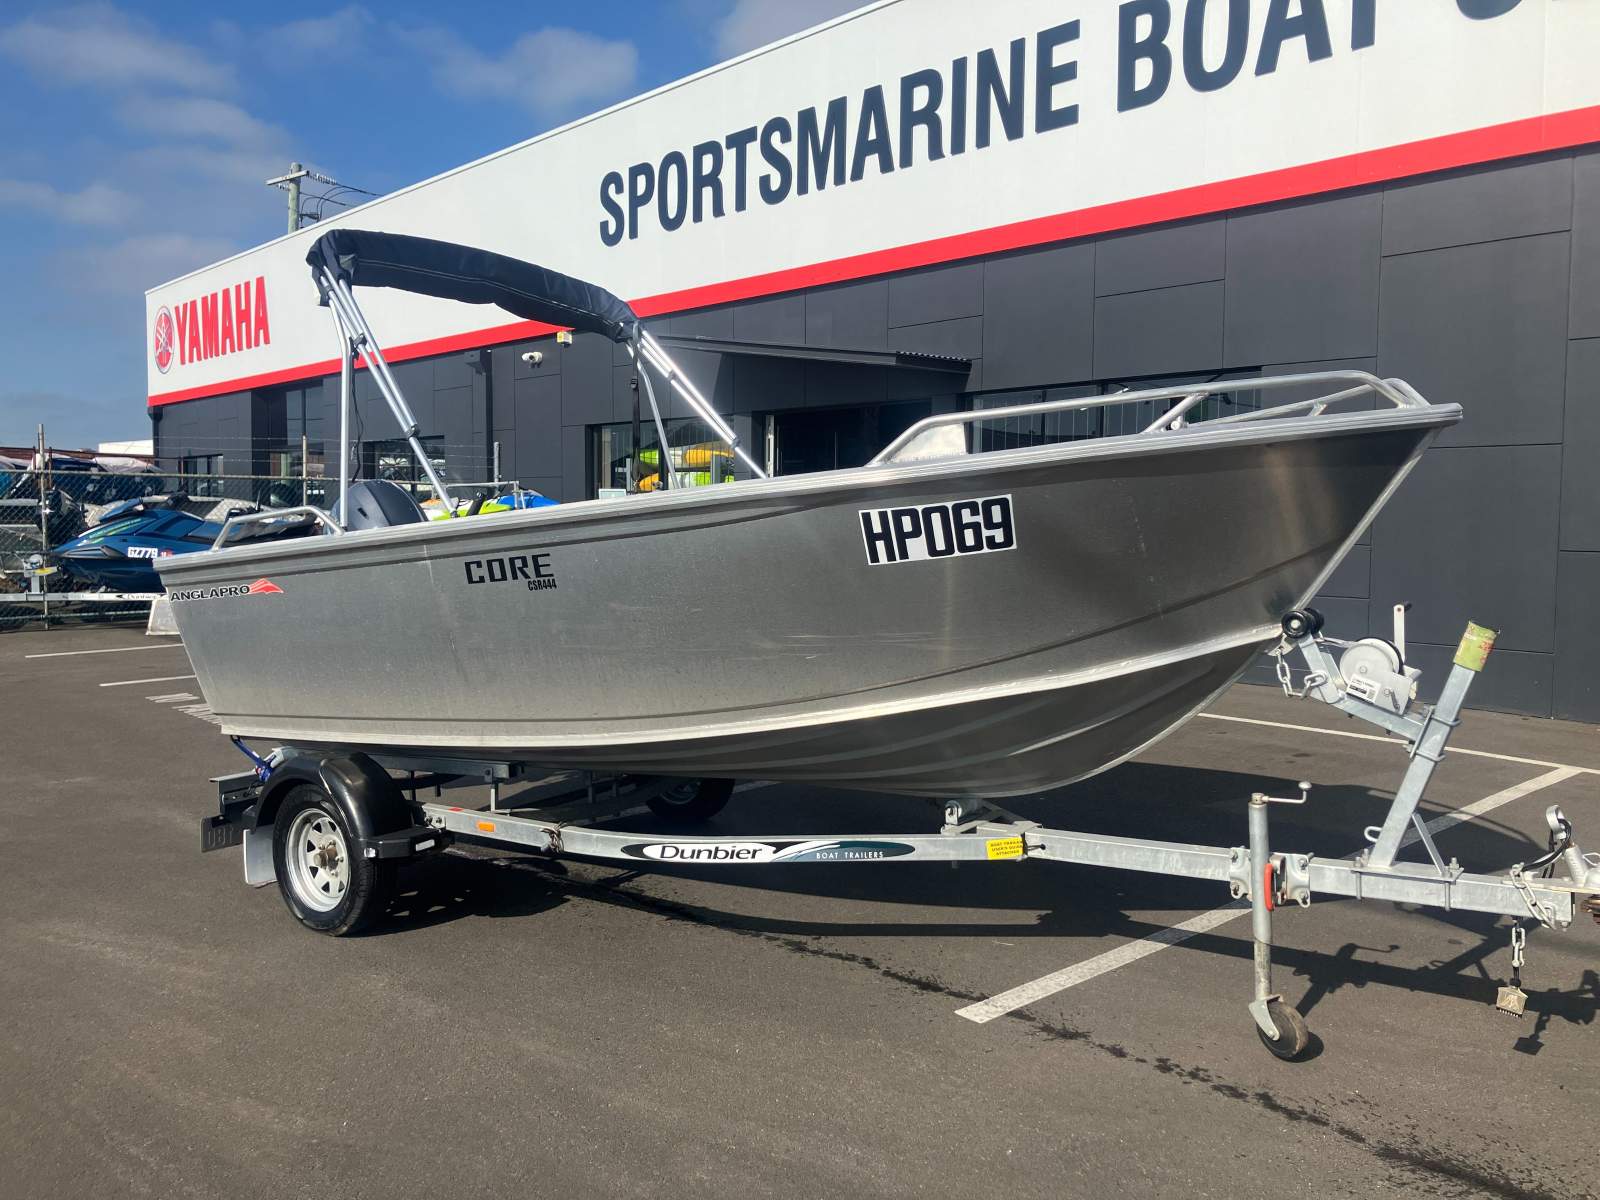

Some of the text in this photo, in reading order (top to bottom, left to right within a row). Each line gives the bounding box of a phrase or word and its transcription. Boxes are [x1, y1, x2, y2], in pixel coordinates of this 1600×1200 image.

[599, 18, 1081, 247] SPORTSMARINE
[174, 275, 271, 366] YAMAHA
[860, 496, 1015, 564] HP069
[464, 552, 555, 585] CORE
[527, 578, 558, 592] CSR444
[170, 585, 250, 602] ANGLAPRO
[659, 844, 885, 861] Dunbier BOAT TRAILERS
